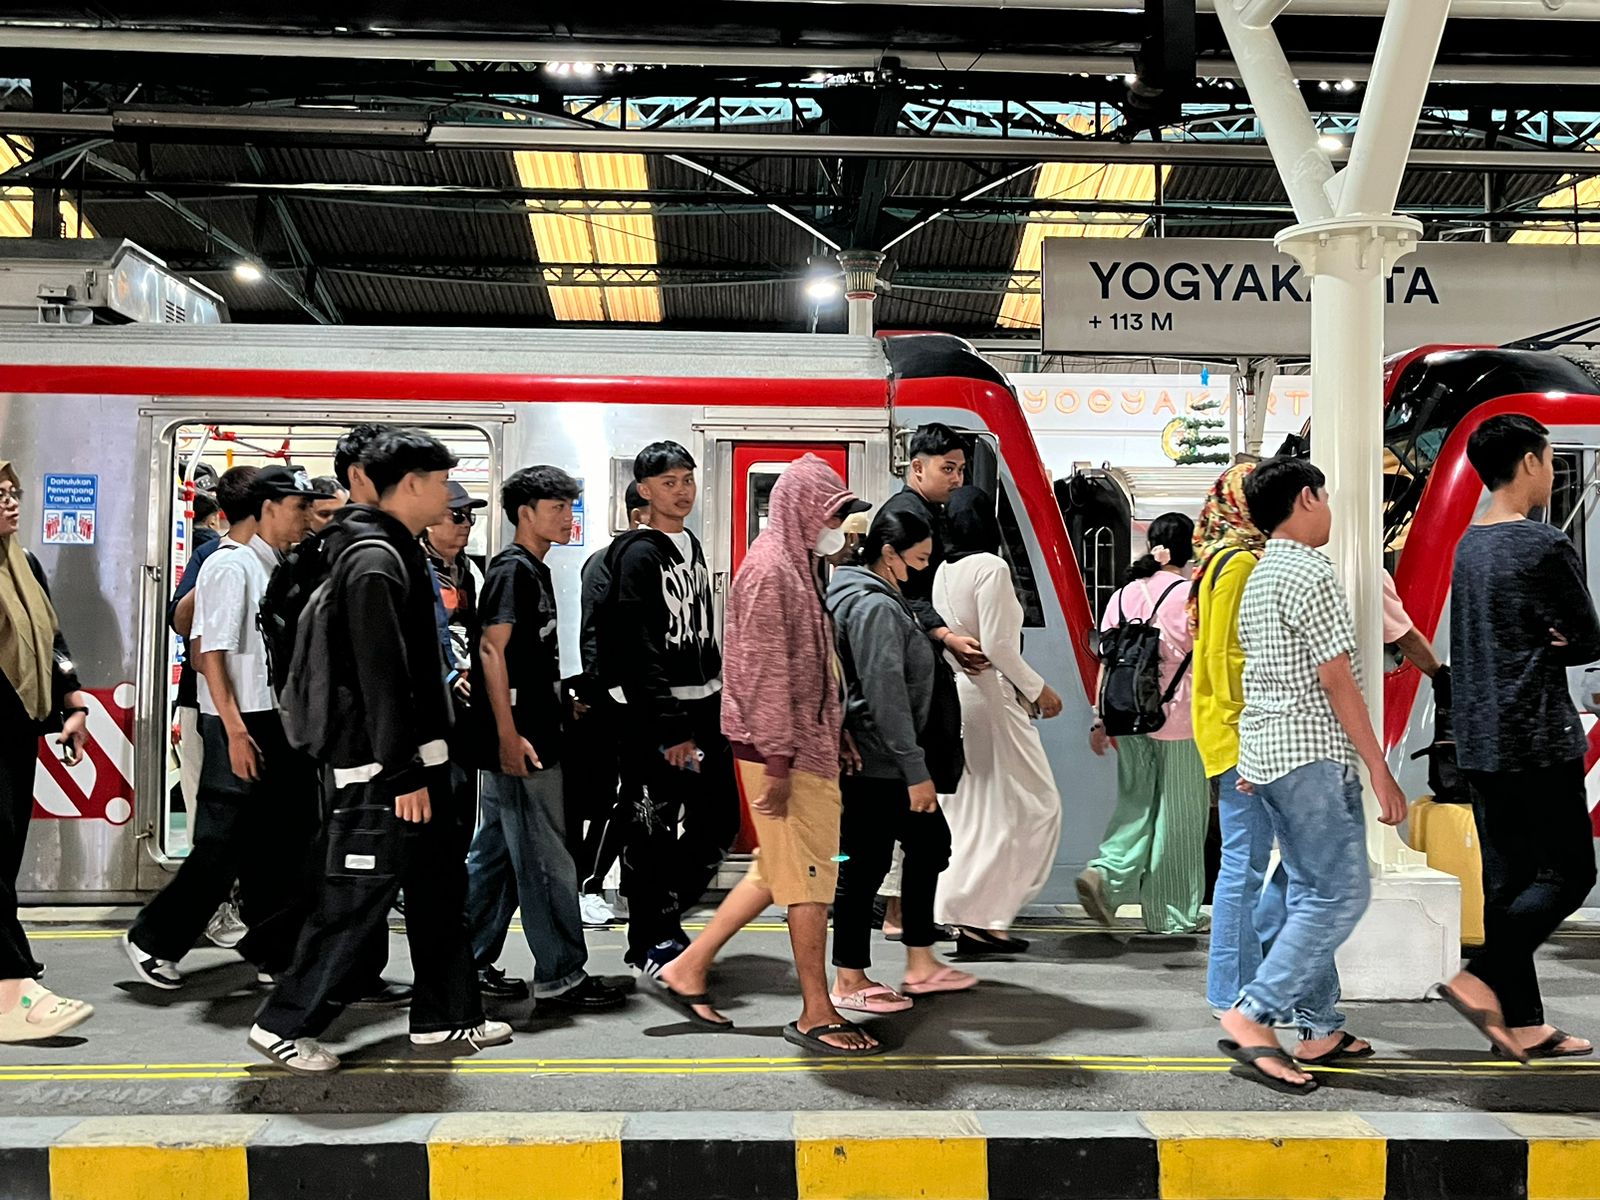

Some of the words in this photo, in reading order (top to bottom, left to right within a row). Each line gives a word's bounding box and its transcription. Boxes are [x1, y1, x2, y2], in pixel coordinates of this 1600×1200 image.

[1089, 261, 1440, 304] YOGYAKTA
[1109, 313, 1143, 330] 113
[1151, 312, 1172, 331] M
[1023, 388, 1310, 415] YOGYAKART
[50, 477, 91, 485] Dahulukan
[47, 486, 94, 495] Penumpang
[49, 495, 70, 504] Yang
